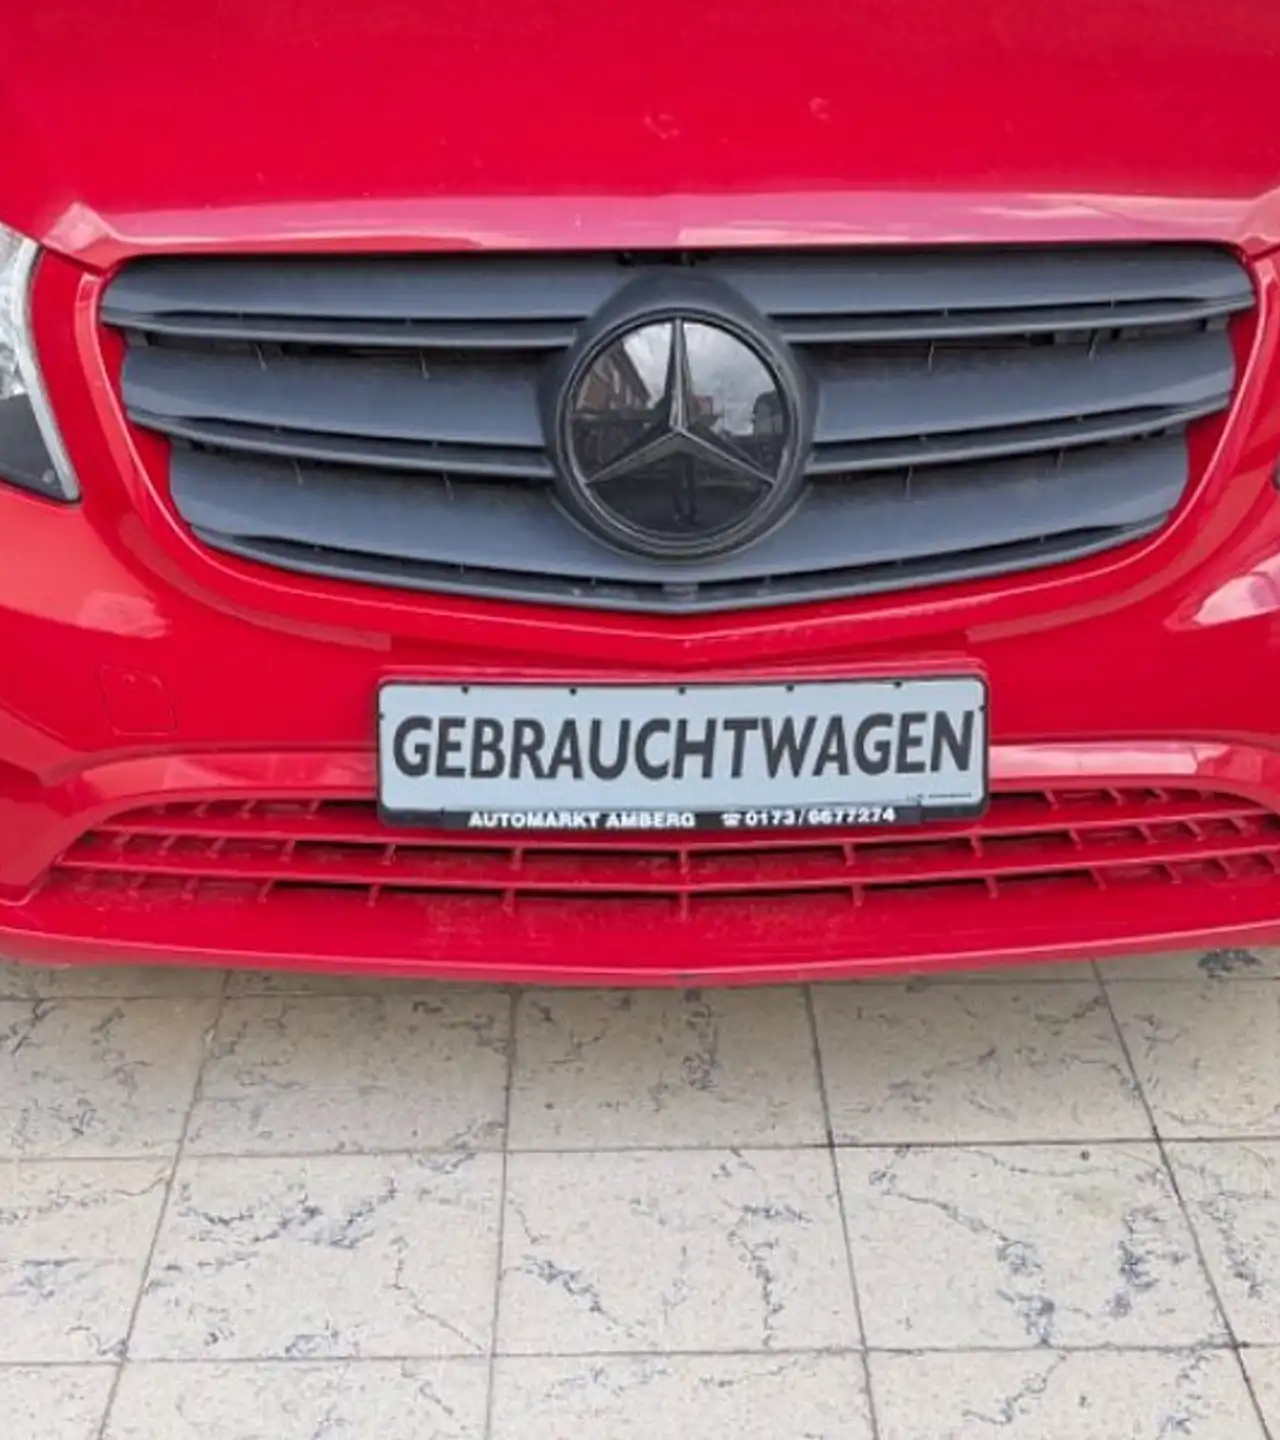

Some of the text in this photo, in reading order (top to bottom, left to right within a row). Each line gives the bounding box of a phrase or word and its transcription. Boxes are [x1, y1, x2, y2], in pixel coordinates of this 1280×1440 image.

[392, 710, 975, 781] GEBRAUCHTWAGEN
[468, 811, 601, 828] AUTOMARKT
[605, 811, 696, 828] AMBERG
